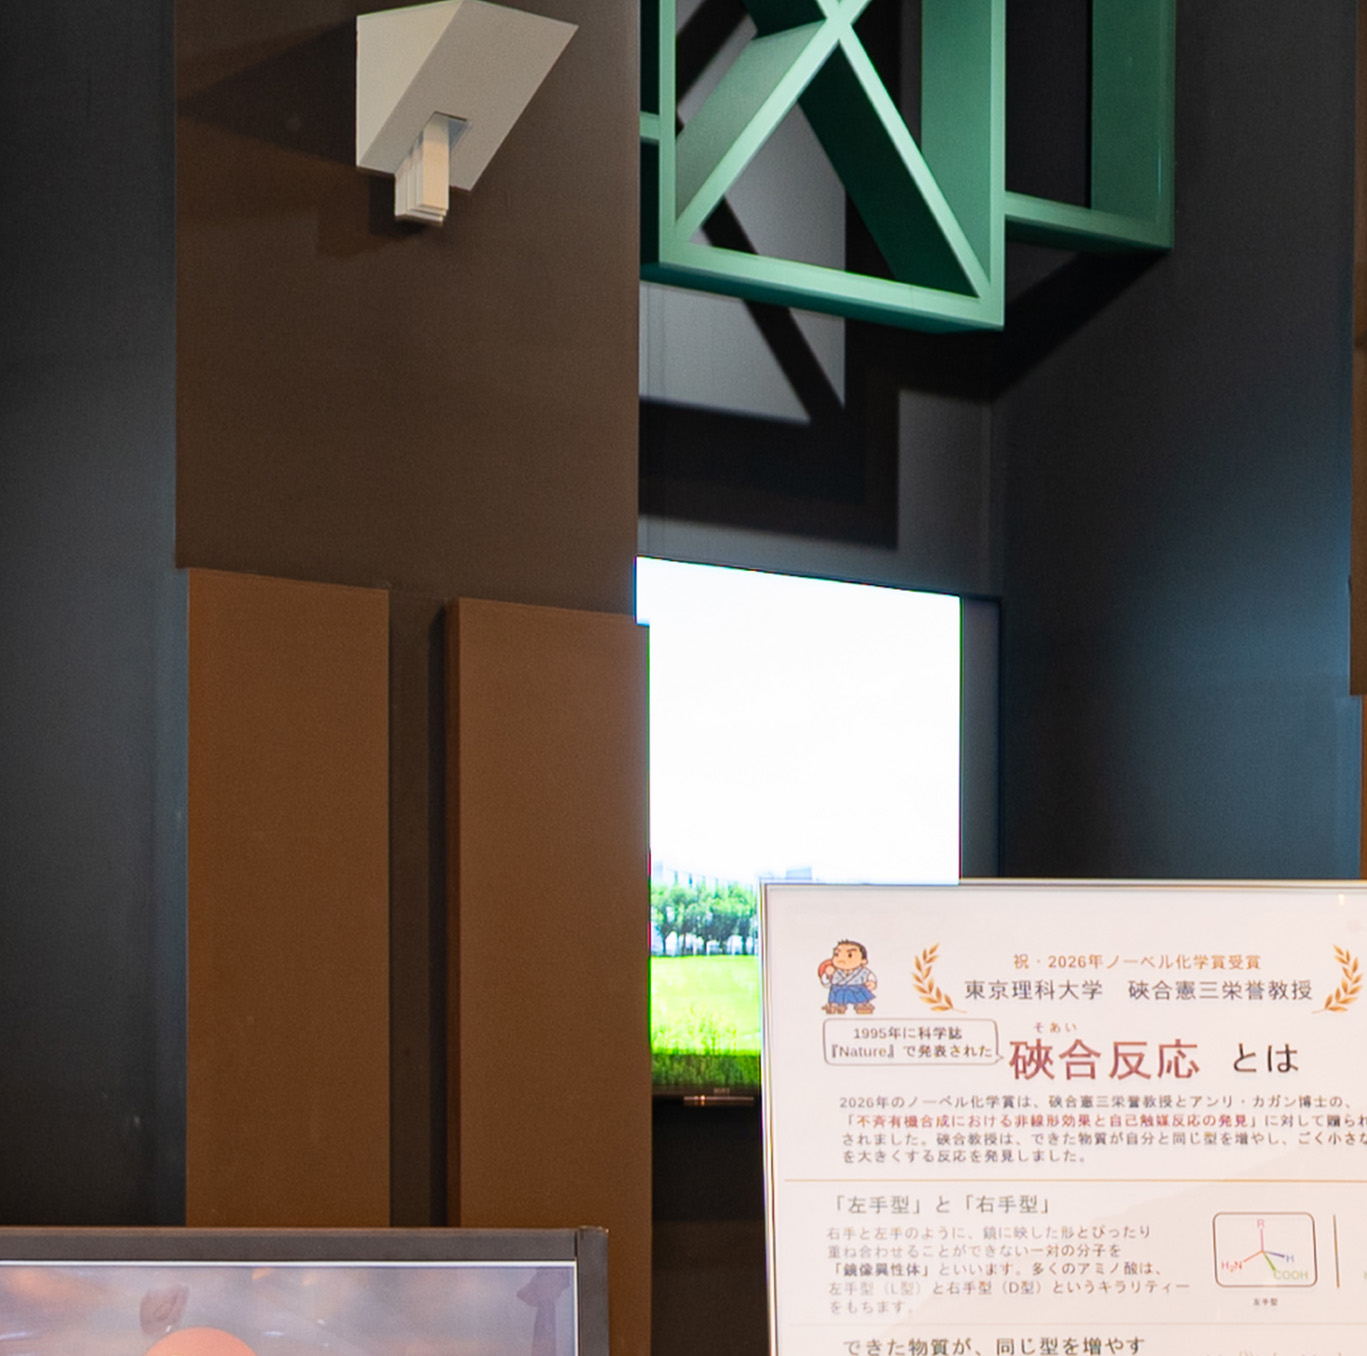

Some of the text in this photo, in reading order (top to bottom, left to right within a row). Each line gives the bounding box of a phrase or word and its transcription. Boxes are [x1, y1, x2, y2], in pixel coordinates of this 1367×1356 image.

[964, 979, 1313, 1001] 東京理科大学 硤合憲三栄誉教授
[853, 1026, 963, 1040] 1995年に科学誌
[1034, 1021, 1078, 1034] そあい
[1008, 1037, 1300, 1081] 硤合反応 とは
[835, 1194, 1052, 1215] 「左手型」と「右手型」
[843, 1337, 1145, 1356] できた物質が、同じ型を増やす
